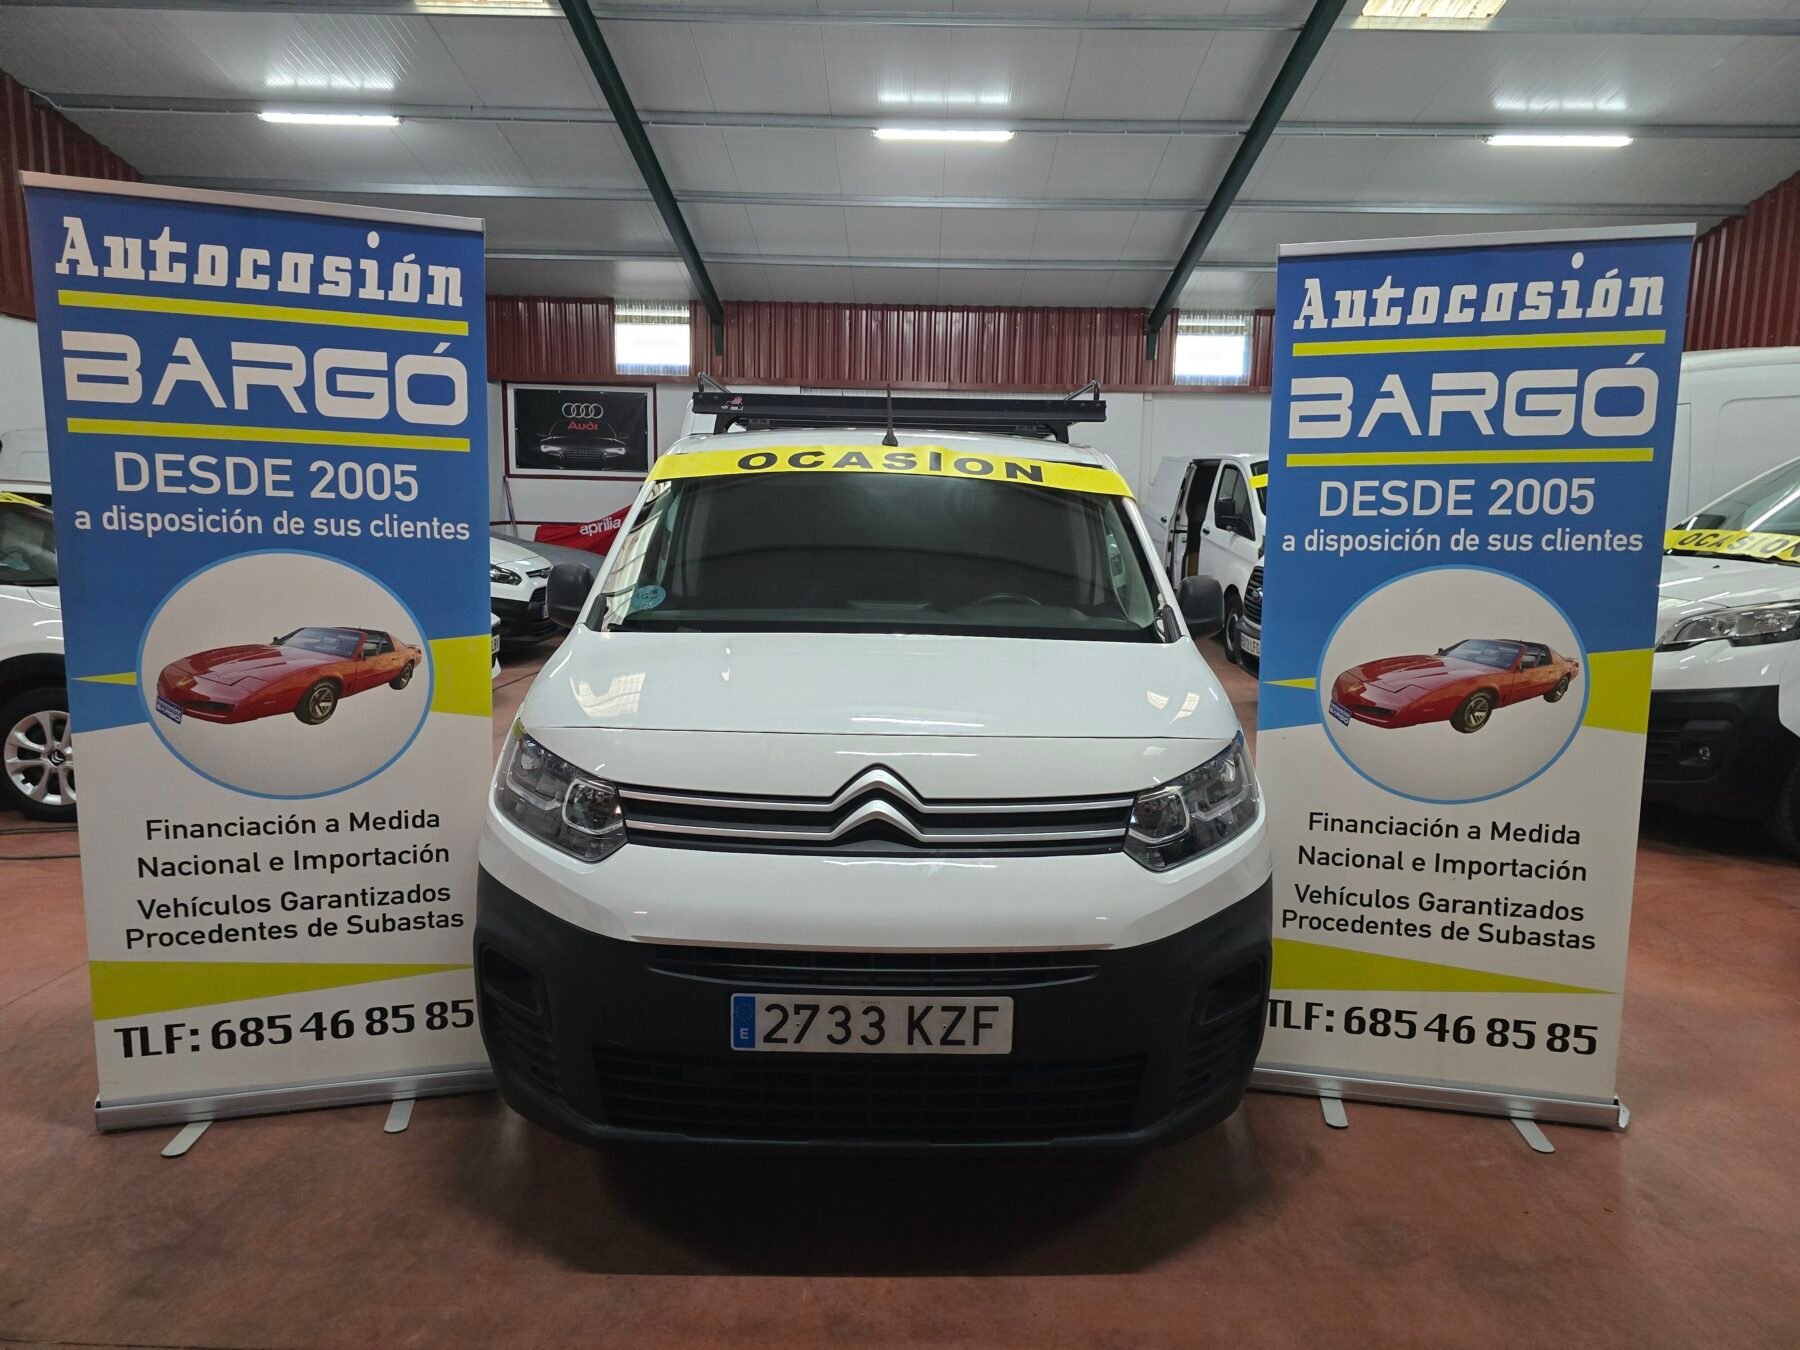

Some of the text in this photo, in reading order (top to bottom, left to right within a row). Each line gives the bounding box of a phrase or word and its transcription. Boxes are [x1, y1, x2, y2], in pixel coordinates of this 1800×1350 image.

[55, 216, 463, 307] Autocasión
[1293, 251, 1664, 330] Autocasión
[61, 330, 469, 426] BARGÓ
[1288, 352, 1659, 439] BARGÓ
[568, 421, 598, 430] Audi
[114, 451, 419, 502] DESDE 2005
[737, 450, 1044, 483] OCASION
[1319, 477, 1595, 517] DESDE 2005
[75, 506, 470, 540] a disposición de sus clientes
[579, 517, 621, 536] aprilia
[1282, 527, 1644, 557] a disposición de sus clientes
[146, 809, 440, 841] Financiación a Medida
[1308, 811, 1581, 845] Financiación a Medida
[137, 843, 450, 878] Nacional e Importación
[1298, 845, 1587, 882] Nacional e Importación
[137, 883, 451, 920] Vehículos Garantizados
[1294, 883, 1585, 922] Vehículos Garantizados
[125, 911, 465, 949] Procedentes de Subastas
[1282, 909, 1596, 950] Procedentes de Subastas
[114, 998, 475, 1058] TLF: 685 46 85 85
[740, 1027, 749, 1040] E
[762, 1003, 999, 1048] 2733 KZF
[1268, 999, 1598, 1055] TLF: 685 46 85 85
